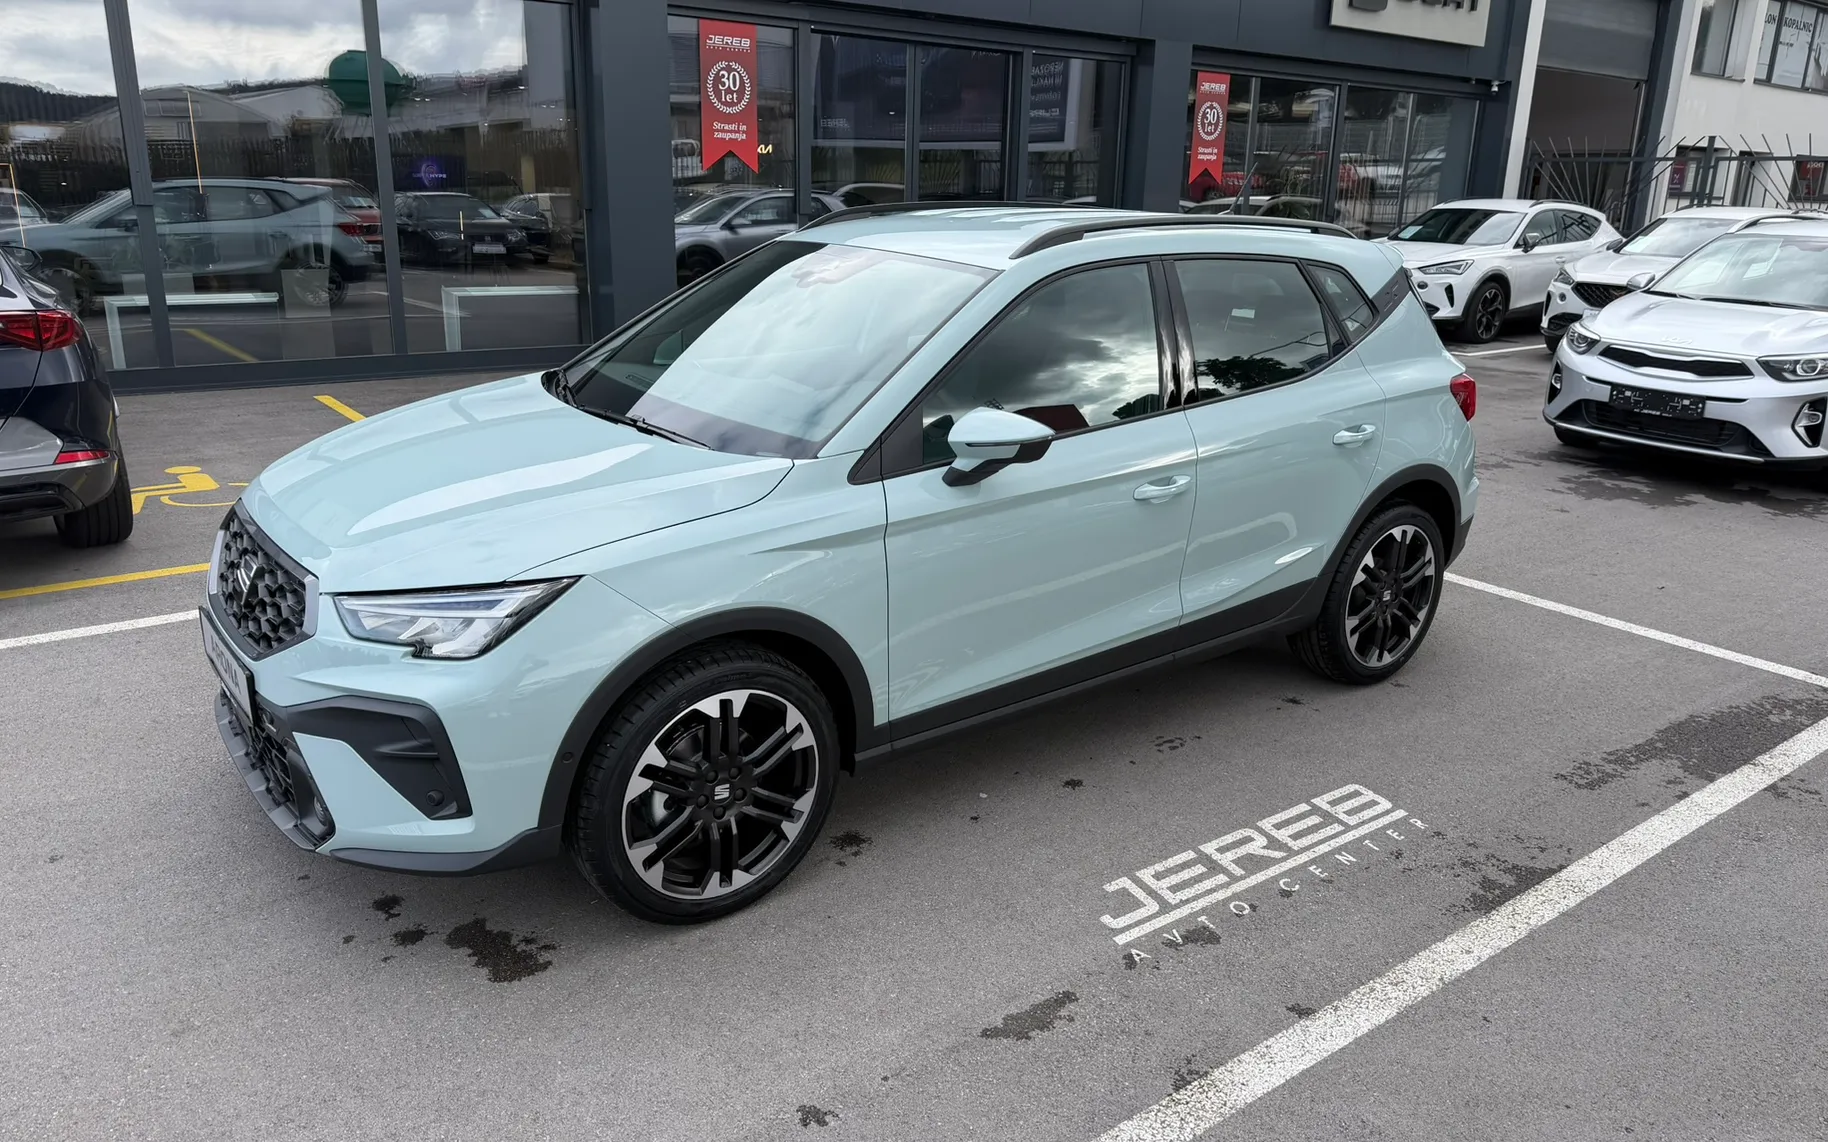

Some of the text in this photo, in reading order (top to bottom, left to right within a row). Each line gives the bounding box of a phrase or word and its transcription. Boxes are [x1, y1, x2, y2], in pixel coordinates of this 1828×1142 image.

[706, 35, 750, 47] JEREB
[718, 70, 740, 91] 30
[1200, 82, 1226, 91] JEREB
[721, 90, 738, 103] let
[1204, 109, 1217, 123] 30
[713, 121, 746, 131] Strasti in
[1204, 124, 1215, 132] let
[713, 131, 746, 141] zaupanja
[1100, 783, 1394, 930] JEREB
[1130, 817, 1429, 964] AVTO CENTER
